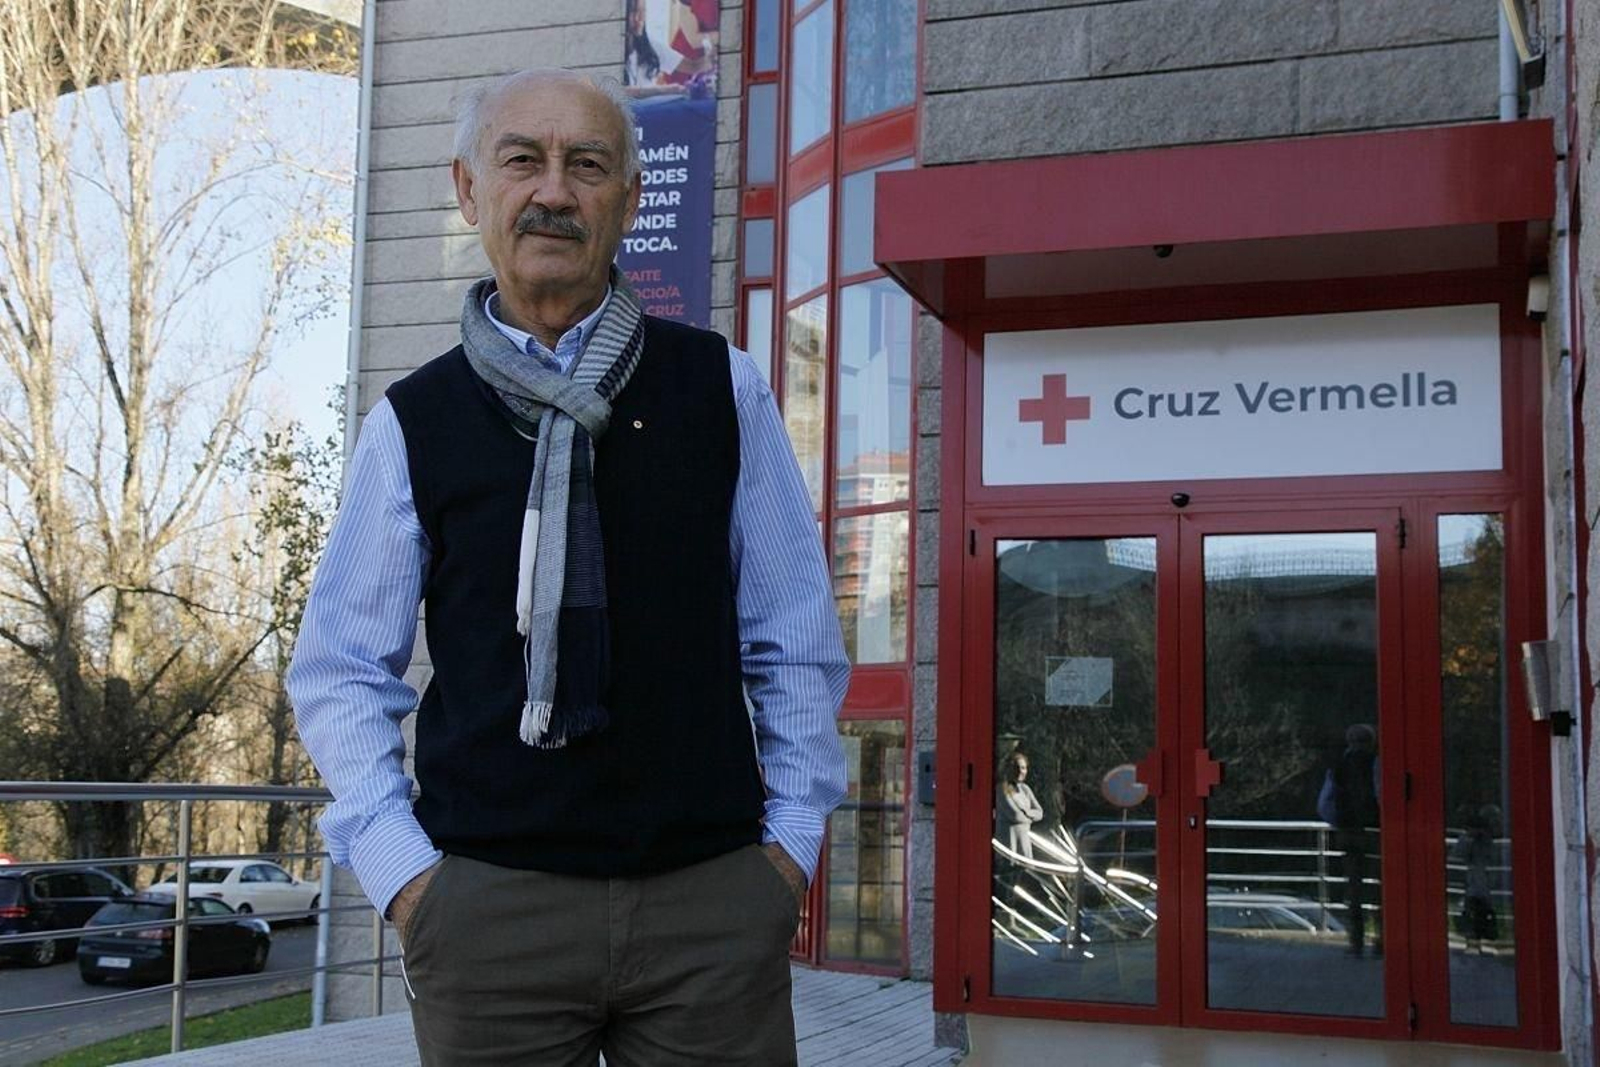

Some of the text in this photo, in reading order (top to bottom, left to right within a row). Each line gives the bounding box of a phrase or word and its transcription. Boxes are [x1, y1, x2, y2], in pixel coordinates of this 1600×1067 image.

[638, 143, 689, 163] AMÉN
[640, 168, 688, 185] ODES
[638, 191, 681, 208] STAR
[623, 236, 678, 253] TOCA.
[633, 285, 681, 299] CIO/A
[1114, 372, 1458, 419] Cruz Vermella
